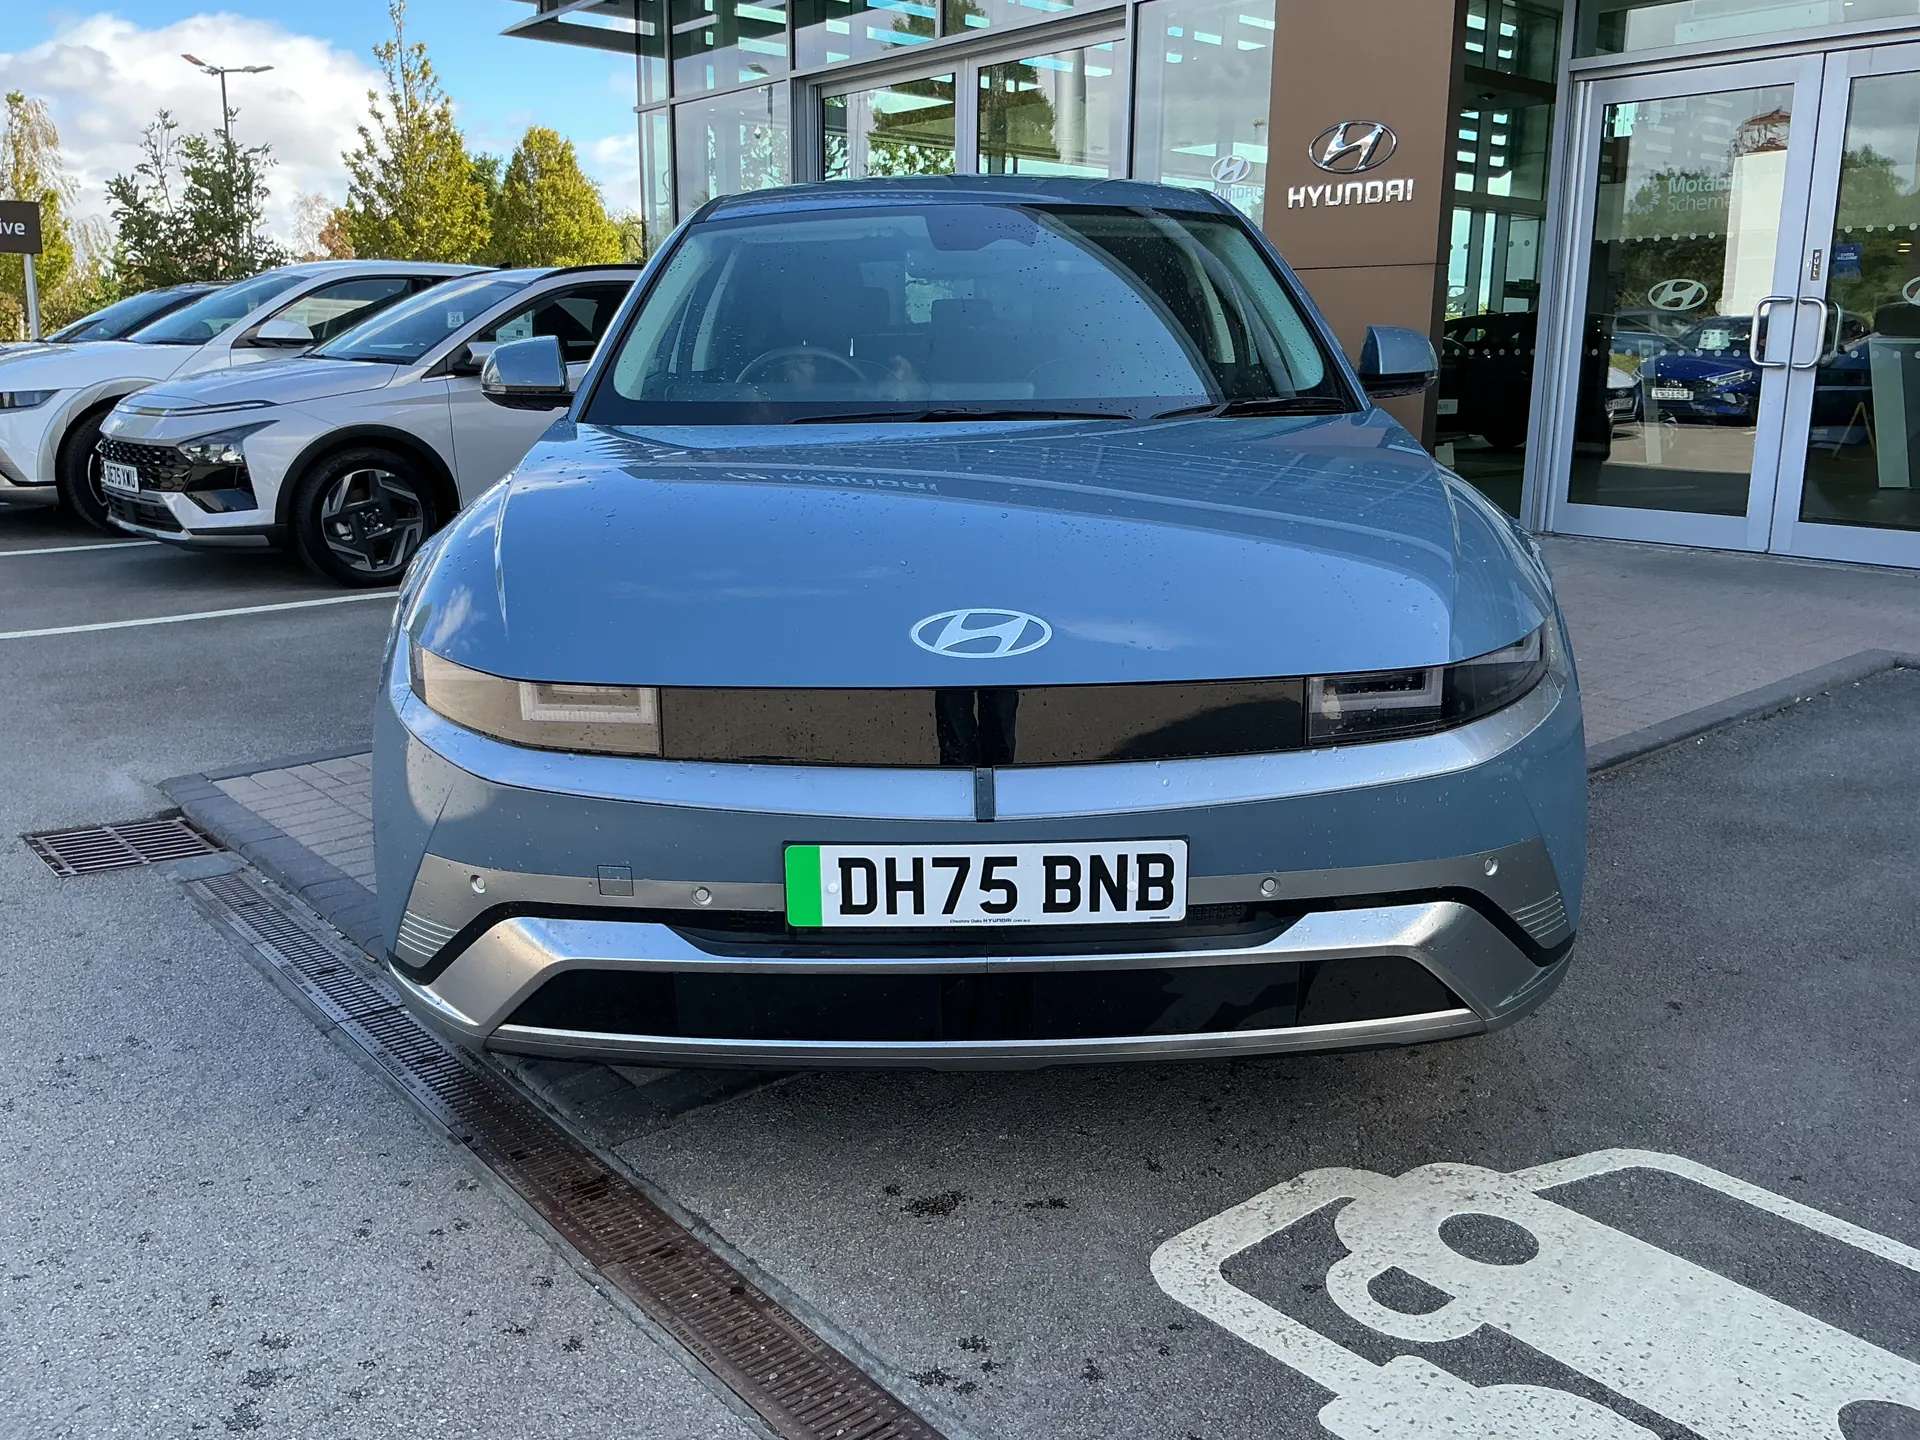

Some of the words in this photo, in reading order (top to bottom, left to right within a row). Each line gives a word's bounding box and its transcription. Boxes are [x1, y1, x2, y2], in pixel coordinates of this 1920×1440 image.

[1287, 179, 1414, 208] HYUNDAI
[1812, 252, 1820, 278] PULL
[838, 856, 1018, 915] DH75
[1042, 853, 1175, 913] BNB
